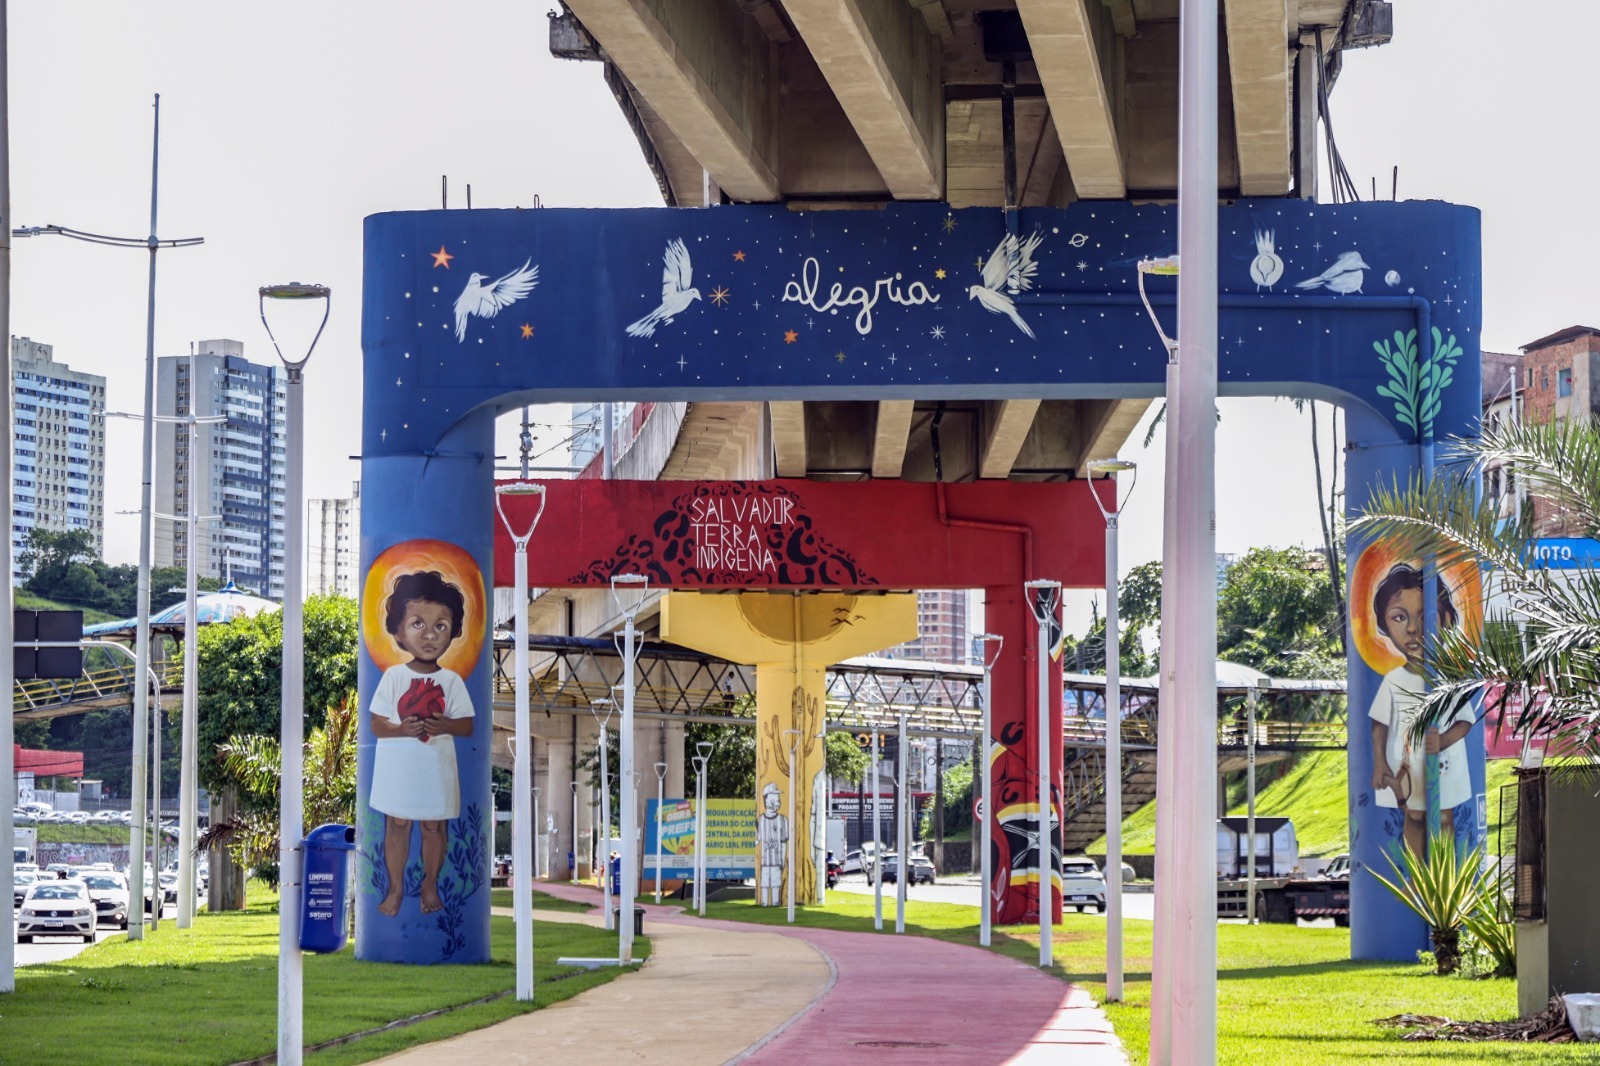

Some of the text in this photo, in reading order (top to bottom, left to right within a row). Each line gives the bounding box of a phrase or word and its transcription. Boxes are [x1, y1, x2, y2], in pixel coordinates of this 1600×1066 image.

[781, 257, 941, 335] alegria
[691, 497, 794, 524] SALVADOR
[690, 523, 761, 549] TERRA
[1527, 546, 1572, 560] MOTO
[726, 841, 740, 849] LEAL
[309, 873, 333, 881] LIMPURB
